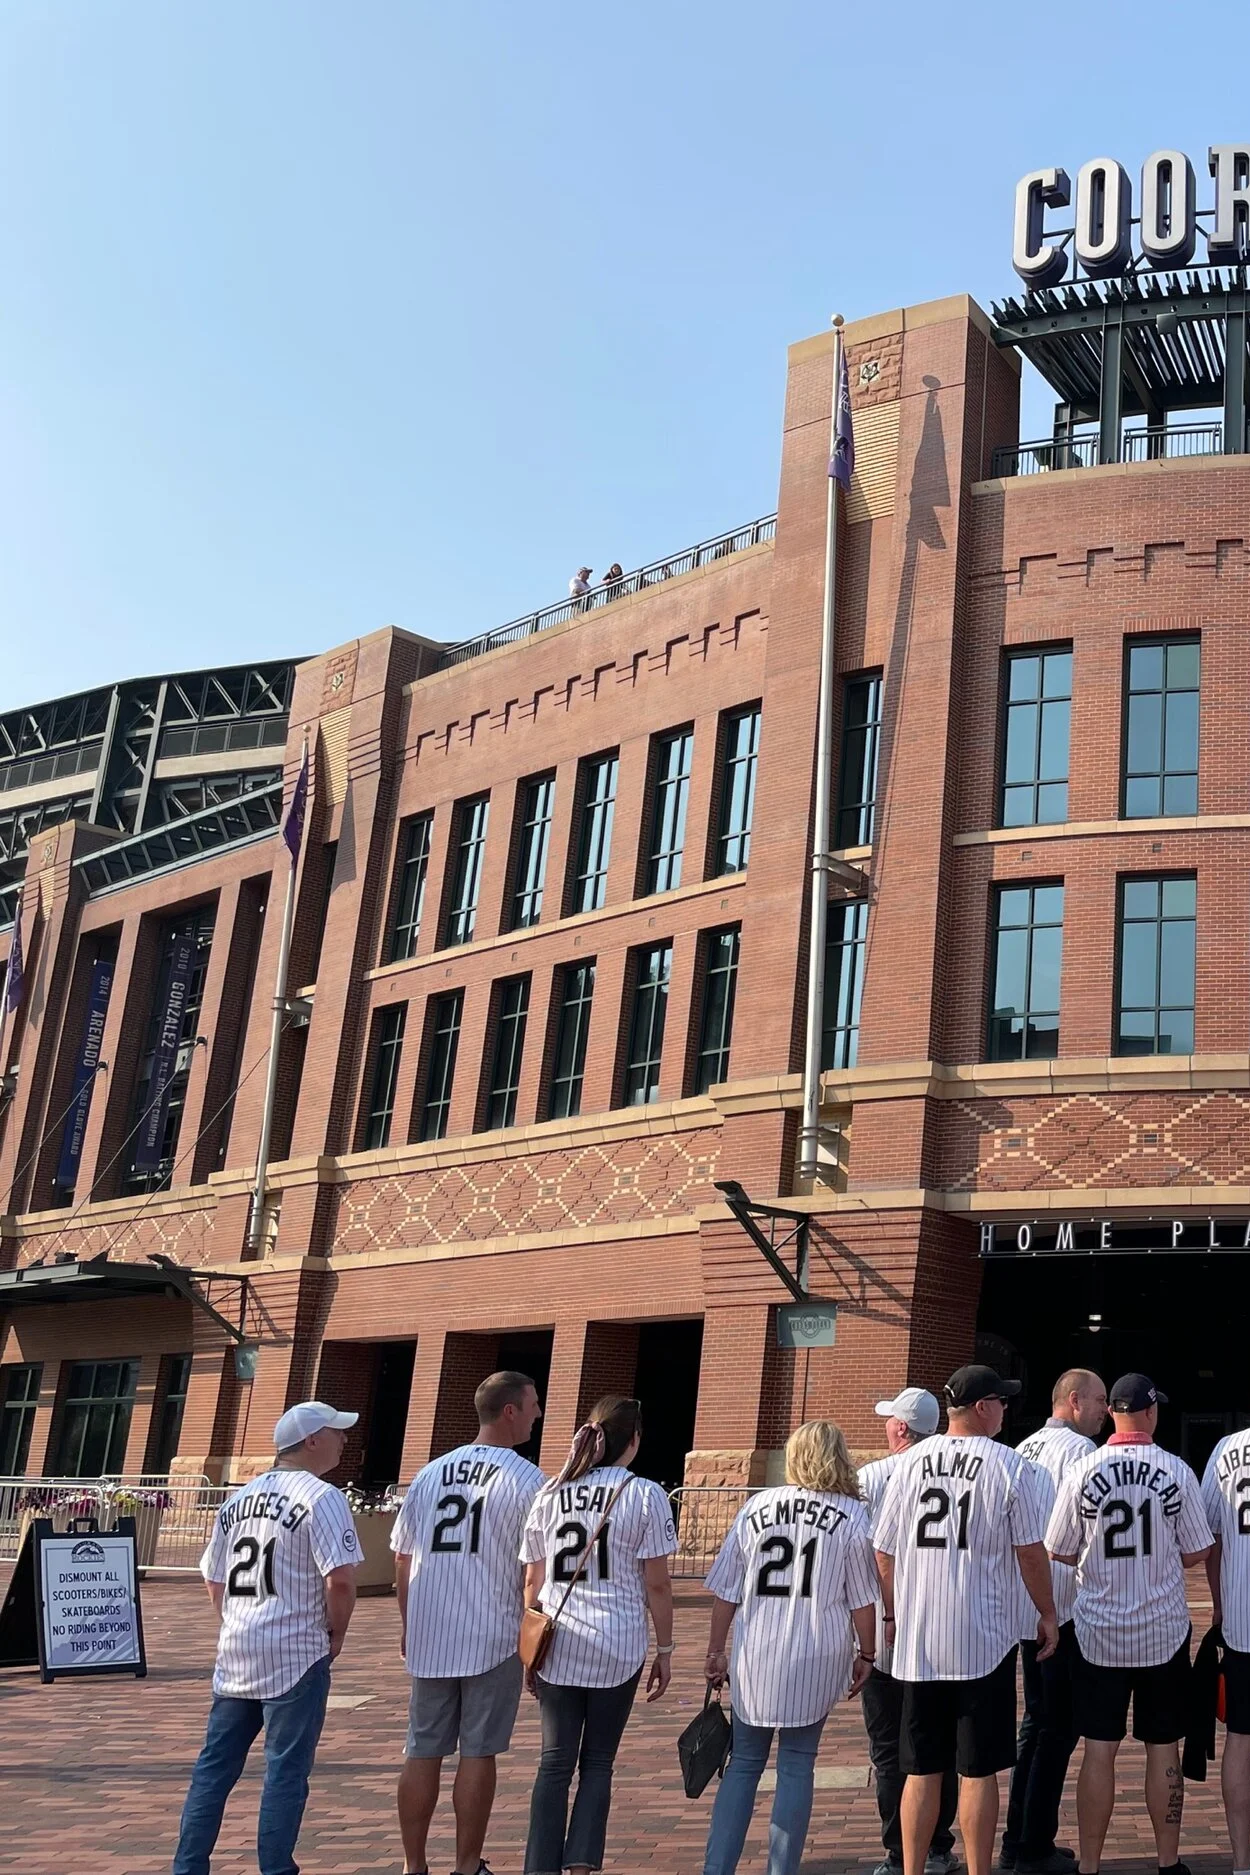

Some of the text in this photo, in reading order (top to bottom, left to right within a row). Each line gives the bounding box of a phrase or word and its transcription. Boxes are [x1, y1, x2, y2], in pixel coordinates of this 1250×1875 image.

[177, 947, 191, 970] 2010
[98, 975, 110, 995] 2014
[161, 981, 185, 1048] GONZALEZ
[83, 1010, 104, 1067] ARENADO
[980, 1222, 1113, 1251] HOME
[922, 1452, 983, 1482] ALMO
[1022, 1441, 1045, 1461] PSA
[442, 1460, 500, 1487] USAV
[1080, 1461, 1182, 1520] RED THREAD
[220, 1492, 289, 1536] BRIDGES
[430, 1494, 485, 1554] 21
[747, 1498, 848, 1535] TEMPSET
[917, 1487, 971, 1549] 21
[1103, 1499, 1153, 1559] 21
[229, 1537, 277, 1597] 21
[553, 1521, 610, 1581] 21
[757, 1536, 818, 1597] 21
[59, 1571, 119, 1583] DISMOUNT ALL
[53, 1587, 126, 1601] SCOOTERS/BIKES/
[62, 1605, 121, 1617] SKATEBOARDS
[53, 1621, 131, 1636] NO RIDING BEYOND
[71, 1639, 117, 1652] THIS POINT
